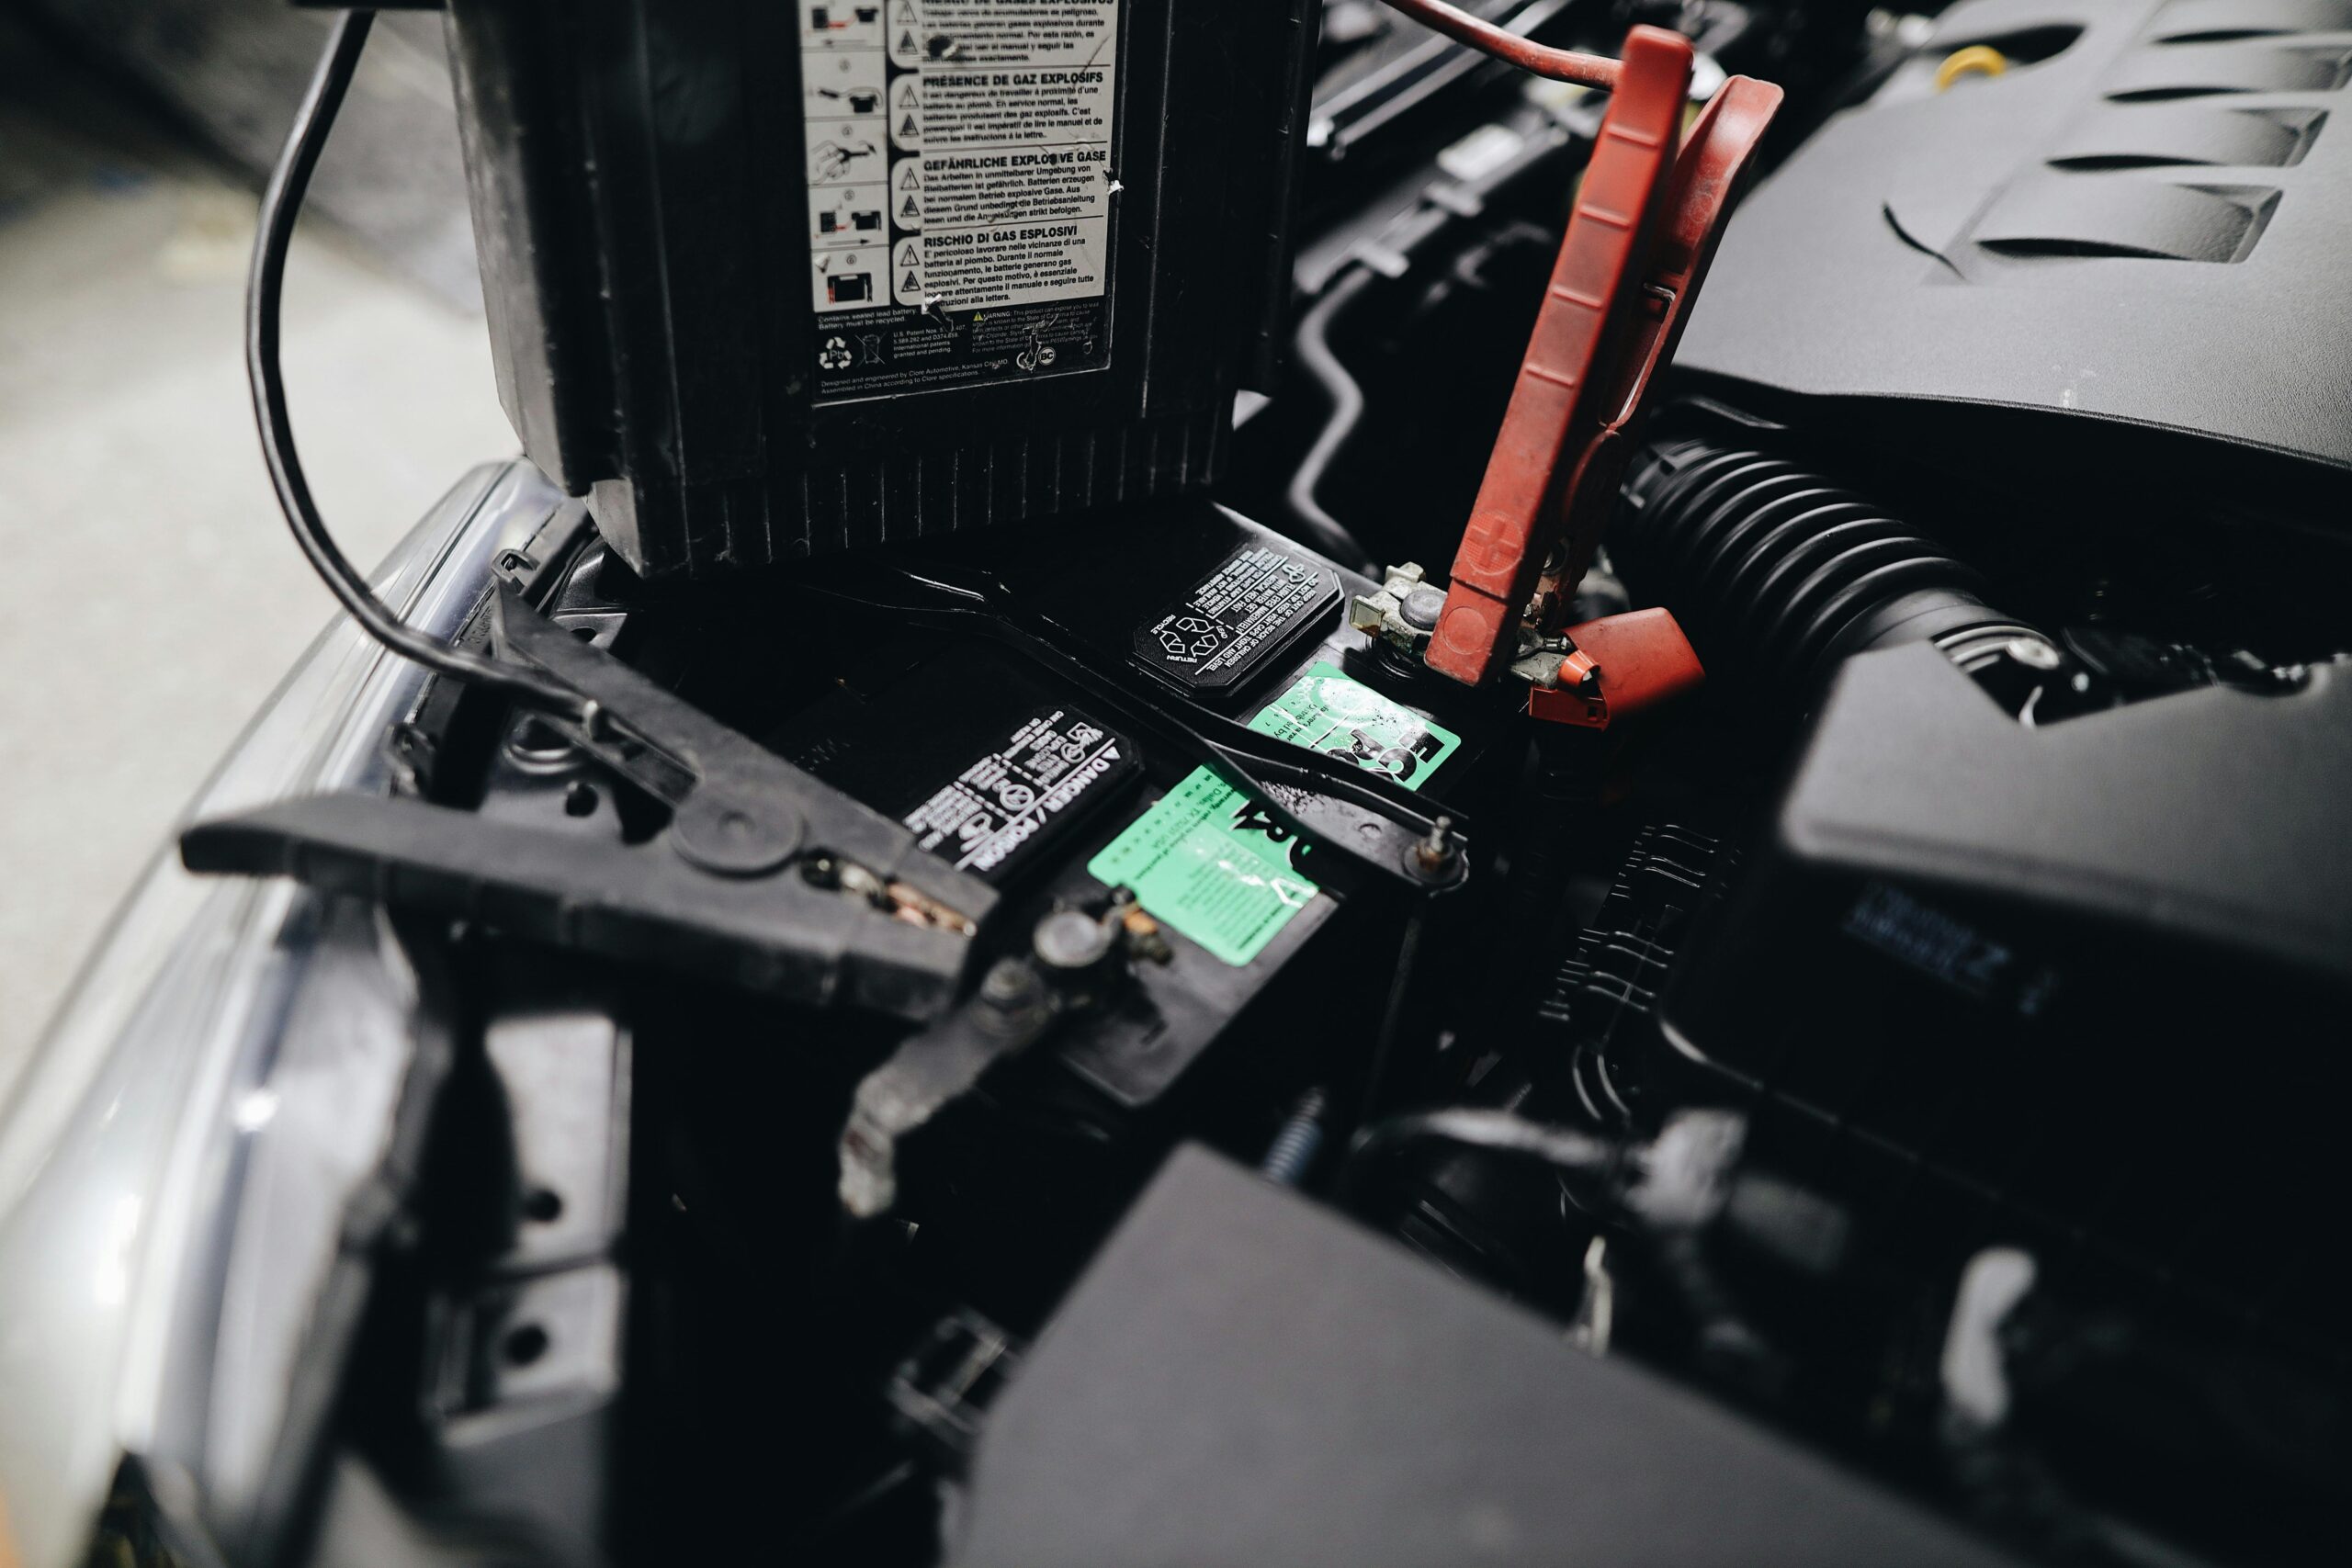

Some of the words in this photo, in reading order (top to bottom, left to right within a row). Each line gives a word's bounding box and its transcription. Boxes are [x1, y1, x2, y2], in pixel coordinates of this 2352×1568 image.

[1061, 8, 1096, 17] peligroso.
[993, 74, 1008, 85] DE
[1012, 73, 1036, 85] GAZ
[1041, 72, 1102, 84] EXPLOSIFS
[1041, 86, 1075, 96] proximité
[1037, 97, 1065, 106] normal,
[1035, 108, 1069, 118] explosifs.
[1071, 107, 1090, 115] C'est
[1056, 118, 1082, 126] manuel
[923, 156, 1006, 170] GEFÄHRLICHE
[1077, 151, 1105, 162] GASE
[985, 169, 1034, 177] unmittelbarer
[1036, 166, 1075, 175] Umgebung
[986, 179, 1023, 190] gefährlich.
[1027, 177, 1059, 186] Batterien
[1061, 175, 1094, 184] erzeugen
[978, 191, 1005, 199] Betrieb
[1007, 188, 1042, 197] explosive
[1044, 186, 1064, 195] Gase.
[954, 203, 978, 211] Grund
[979, 200, 1017, 209] unbedingt
[1033, 195, 1094, 205] Betriebsanleitung
[1029, 208, 1046, 216] strikt
[1049, 206, 1081, 214] befolgen.
[924, 234, 972, 246] RISCHIO
[977, 232, 989, 243] DI
[992, 231, 1016, 242] GAS
[1020, 225, 1077, 239] ESPLOSIVI
[924, 259, 953, 267] batteria
[964, 255, 994, 265] piombo.
[997, 253, 1025, 261] Durante
[1034, 249, 1063, 257] normale
[933, 248, 974, 258] pericoloso
[924, 267, 982, 277] funzionamento,
[993, 263, 1021, 271] batterie
[1023, 260, 1057, 270] generano
[1058, 258, 1071, 267] gas
[924, 278, 960, 288] esplosivi.
[977, 275, 1002, 284] questo
[1004, 272, 1031, 280] motivo,
[1039, 266, 1077, 276] essenziale
[955, 285, 1002, 295] attentamente
[1011, 280, 1042, 288] manuale
[1049, 276, 1076, 286] seguire
[1041, 352, 1054, 360] BC
[1298, 585, 1311, 595] NOT
[1301, 589, 1317, 601] KEEP
[1277, 602, 1292, 614] KEEP
[1291, 600, 1304, 610] OUT
[1150, 614, 1176, 635] RECYCLE
[1262, 613, 1278, 625] VENT
[1272, 615, 1285, 626] THE
[1249, 624, 1266, 637] CAPS
[1256, 625, 1275, 639] REACH
[1234, 634, 1252, 650] TIGHT
[1250, 638, 1259, 647] OF
[1166, 655, 1197, 663] RETURN
[1223, 648, 1237, 660] AND
[1225, 645, 1250, 667] CHILDREN
[1206, 655, 1225, 671] LEVEL
[1044, 755, 1109, 810] DANGER
[972, 814, 1037, 869] POISON
